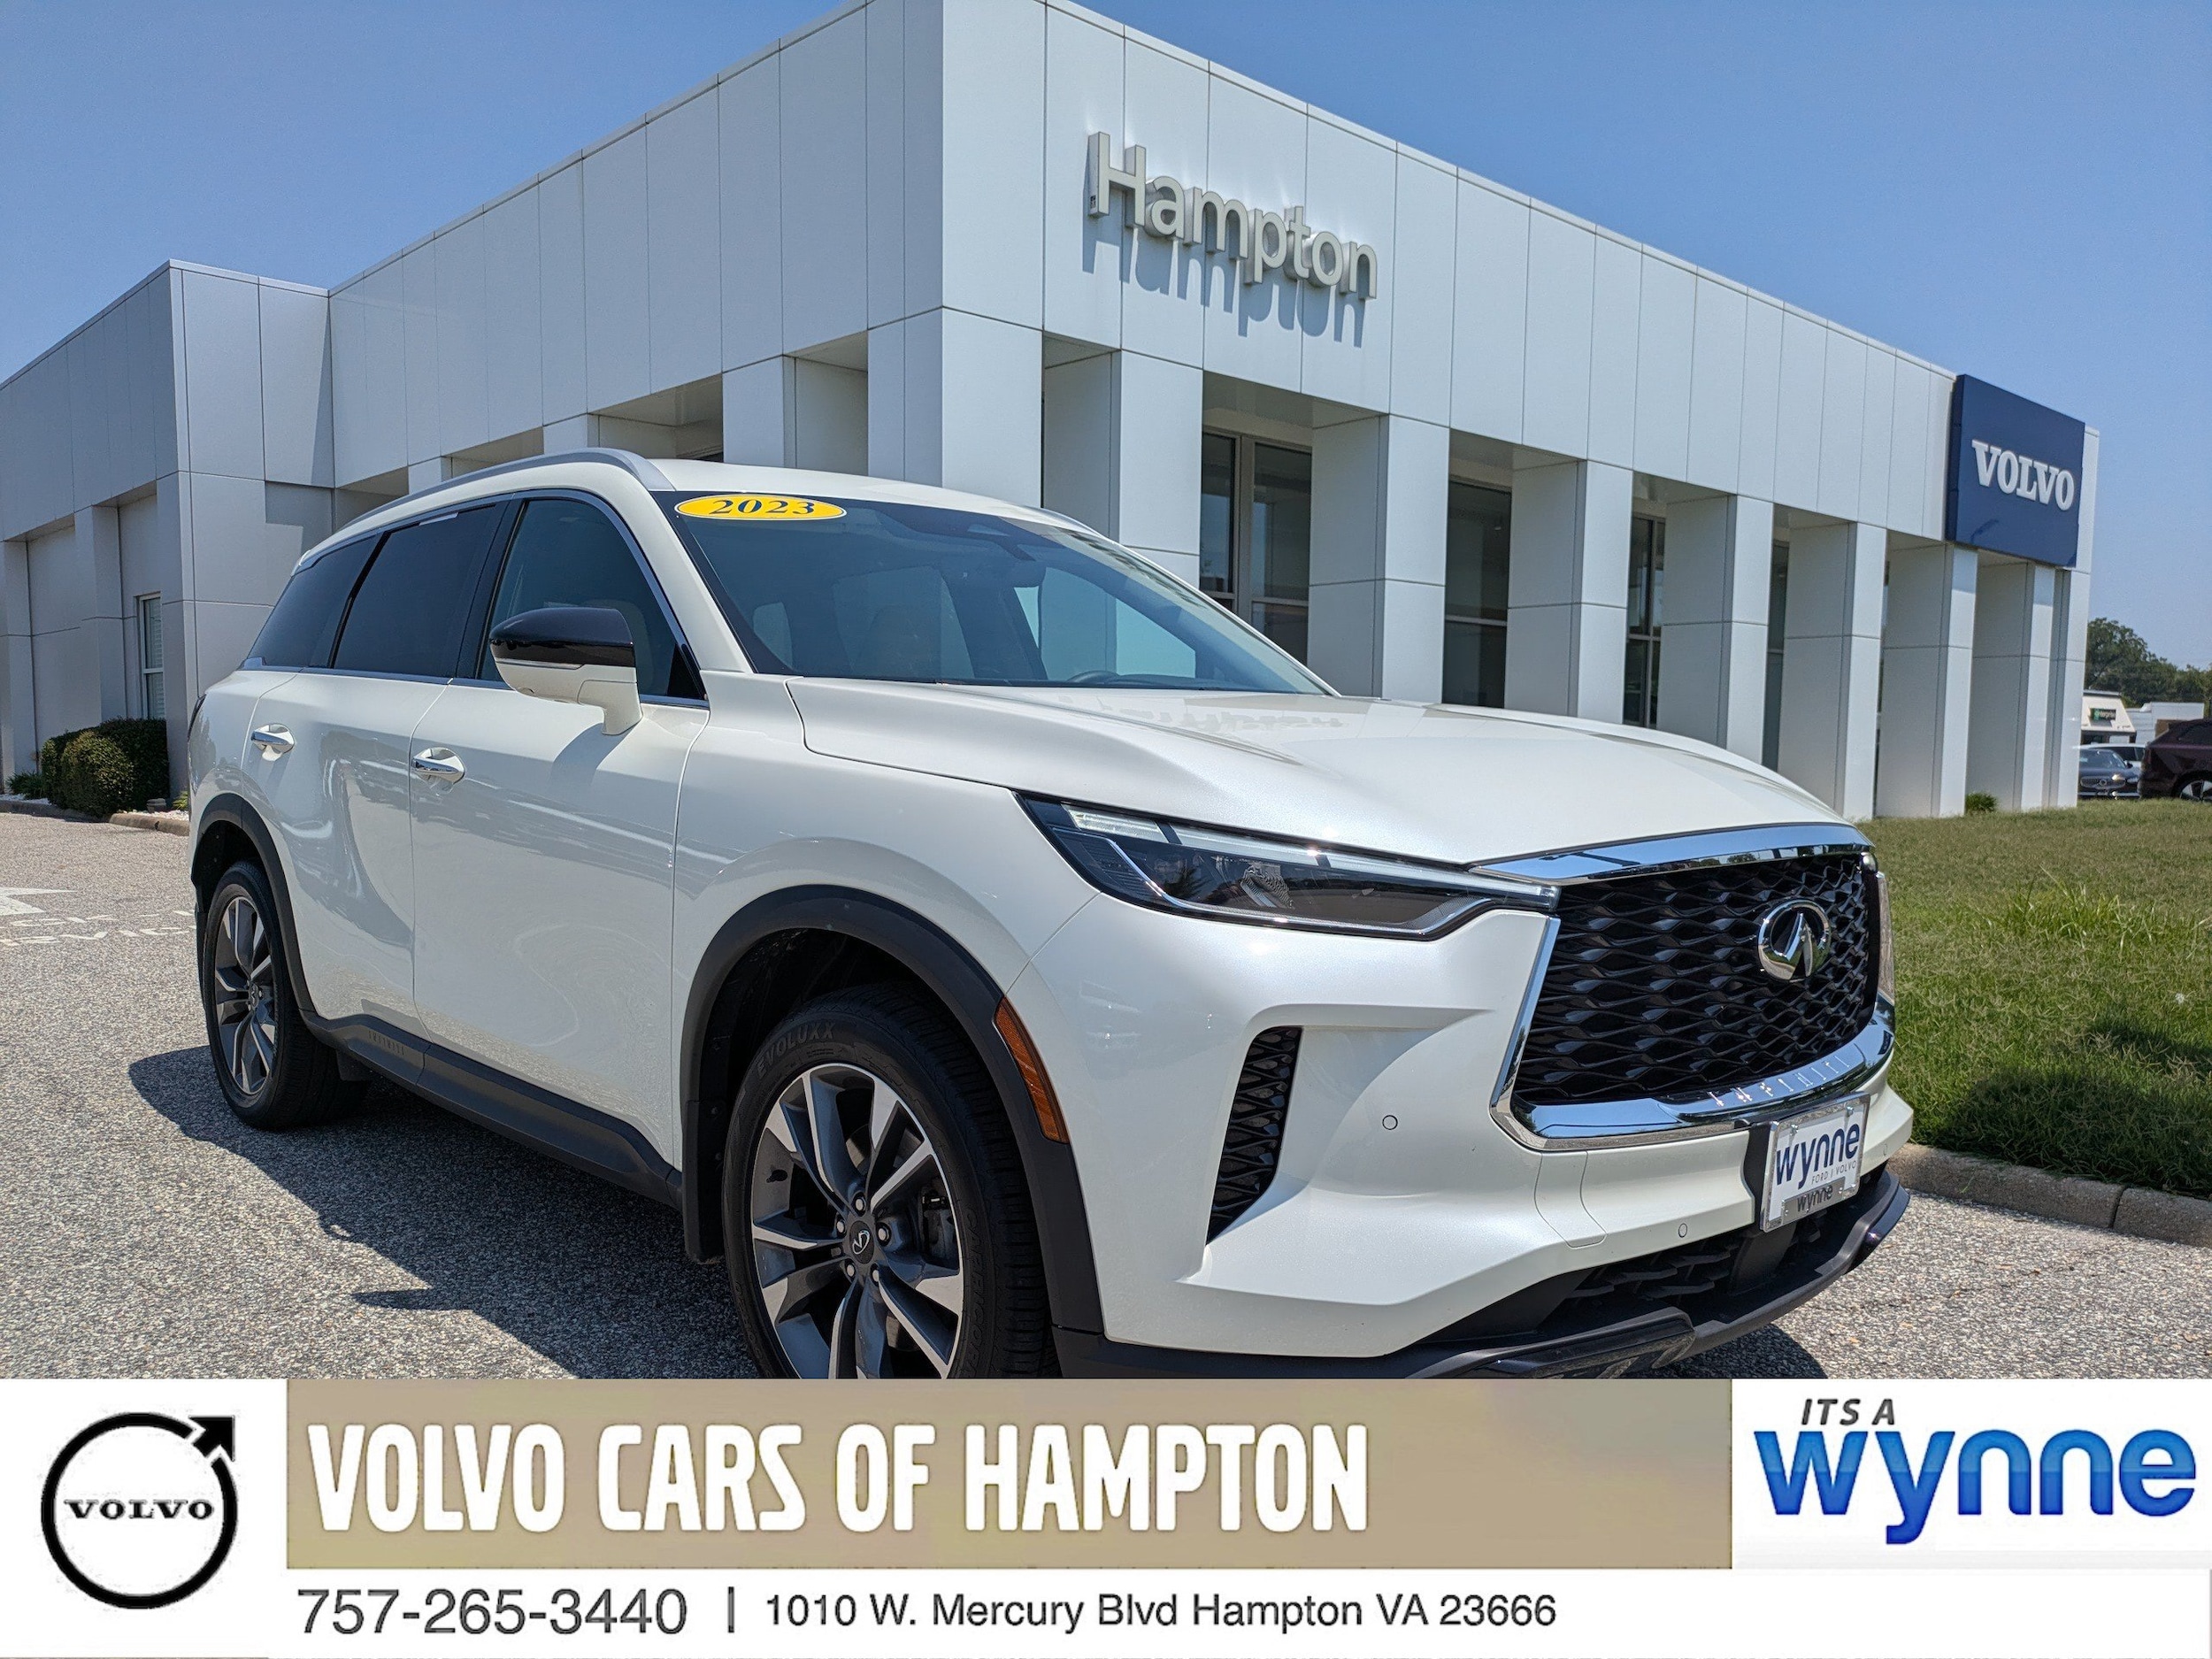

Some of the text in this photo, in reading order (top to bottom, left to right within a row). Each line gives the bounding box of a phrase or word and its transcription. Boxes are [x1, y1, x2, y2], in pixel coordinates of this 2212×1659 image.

[1089, 132, 1377, 299] Hampton
[1971, 440, 2075, 511] VOLVO
[709, 499, 815, 515] 2023
[755, 1019, 836, 1079] EVOLUXX
[1776, 1123, 1860, 1190] wynne
[1811, 1161, 1856, 1185] FORD VOLVO
[1797, 1185, 1833, 1213] wynne
